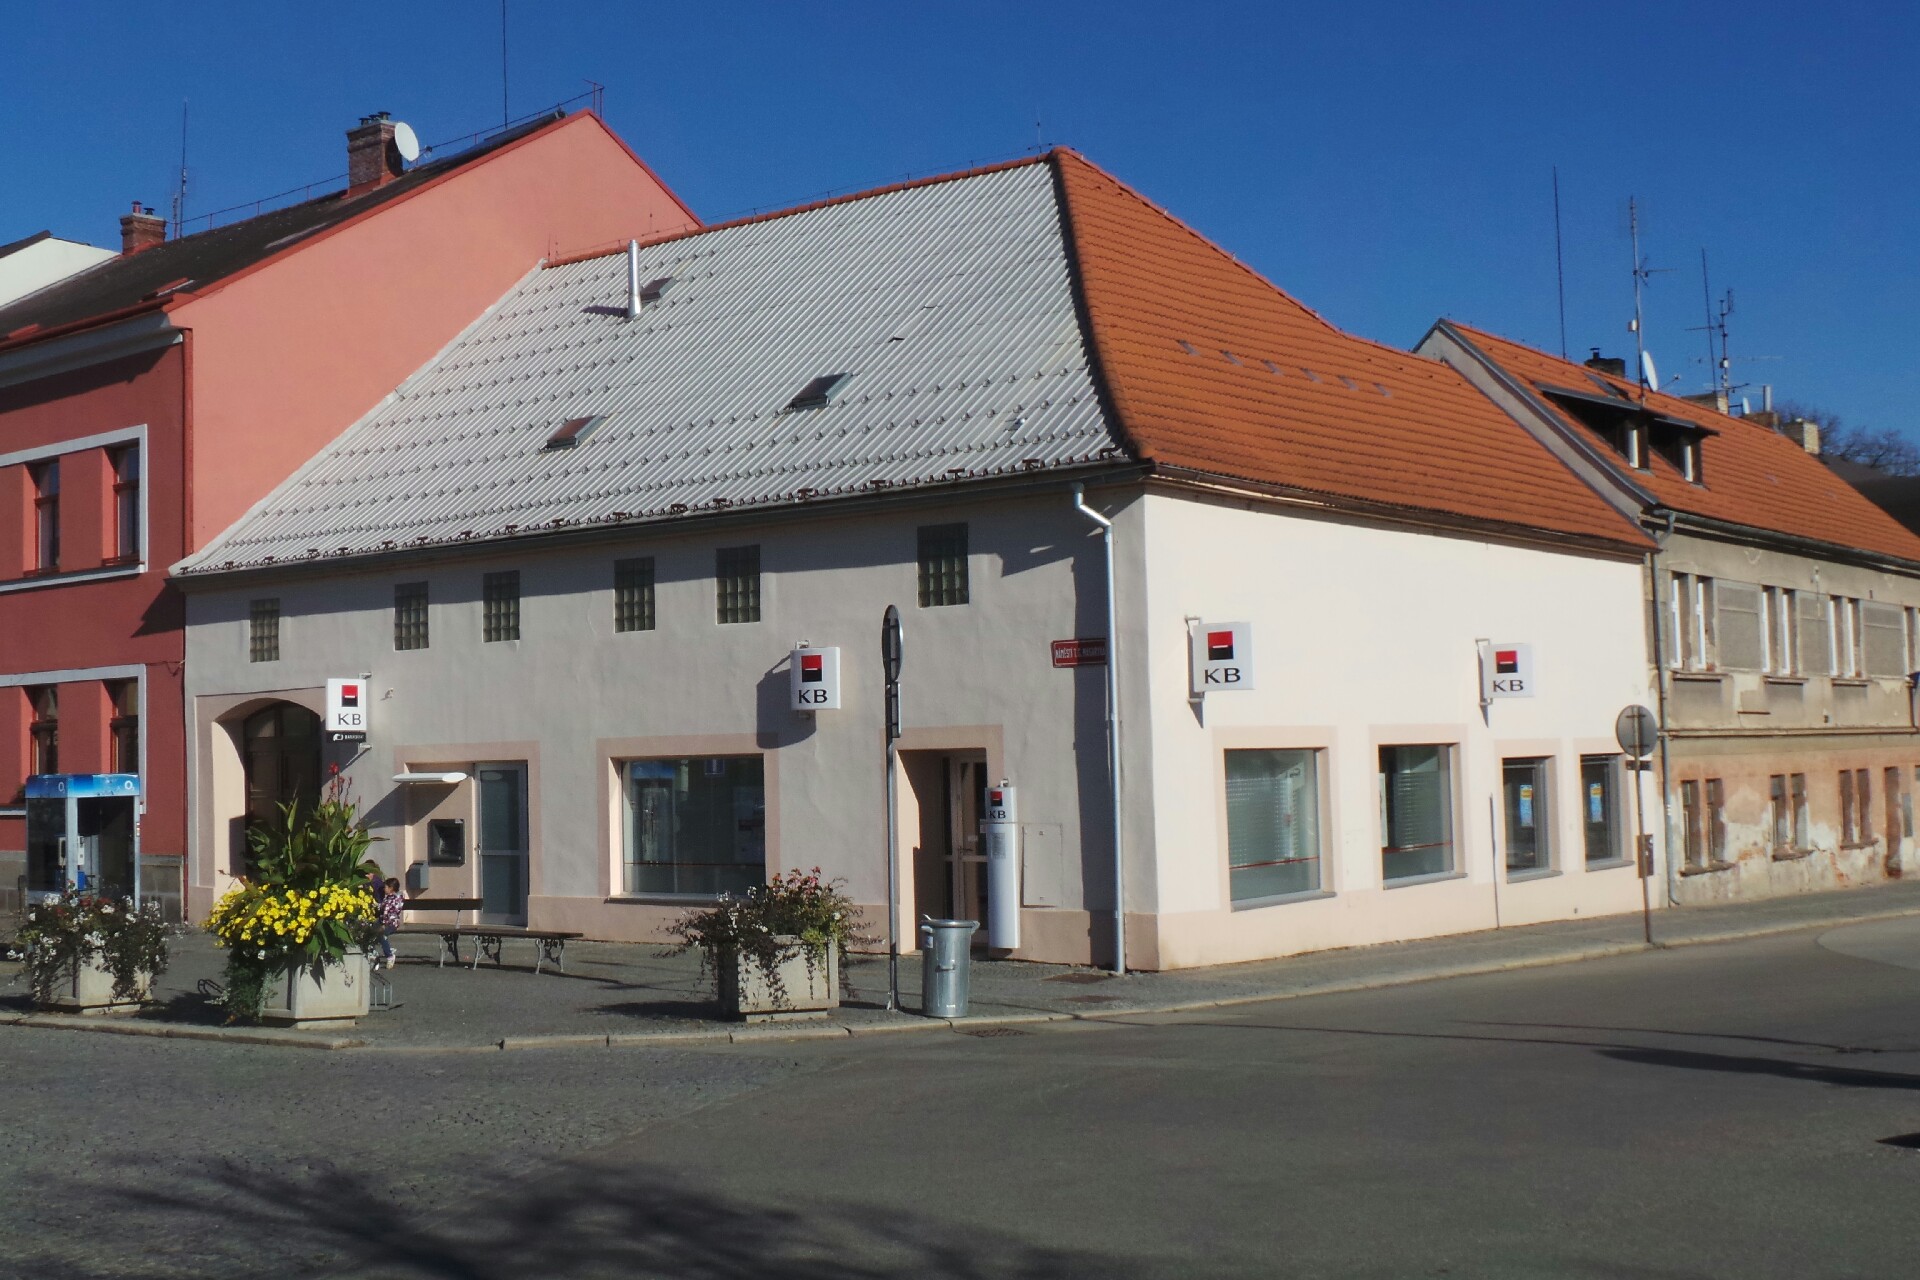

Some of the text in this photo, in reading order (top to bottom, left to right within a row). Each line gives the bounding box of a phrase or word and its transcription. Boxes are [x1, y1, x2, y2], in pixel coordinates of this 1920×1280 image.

[1204, 667, 1241, 684] KB
[1493, 679, 1524, 692] KB
[798, 689, 828, 704] KB
[337, 713, 362, 726] KB
[989, 810, 1006, 819] KB
